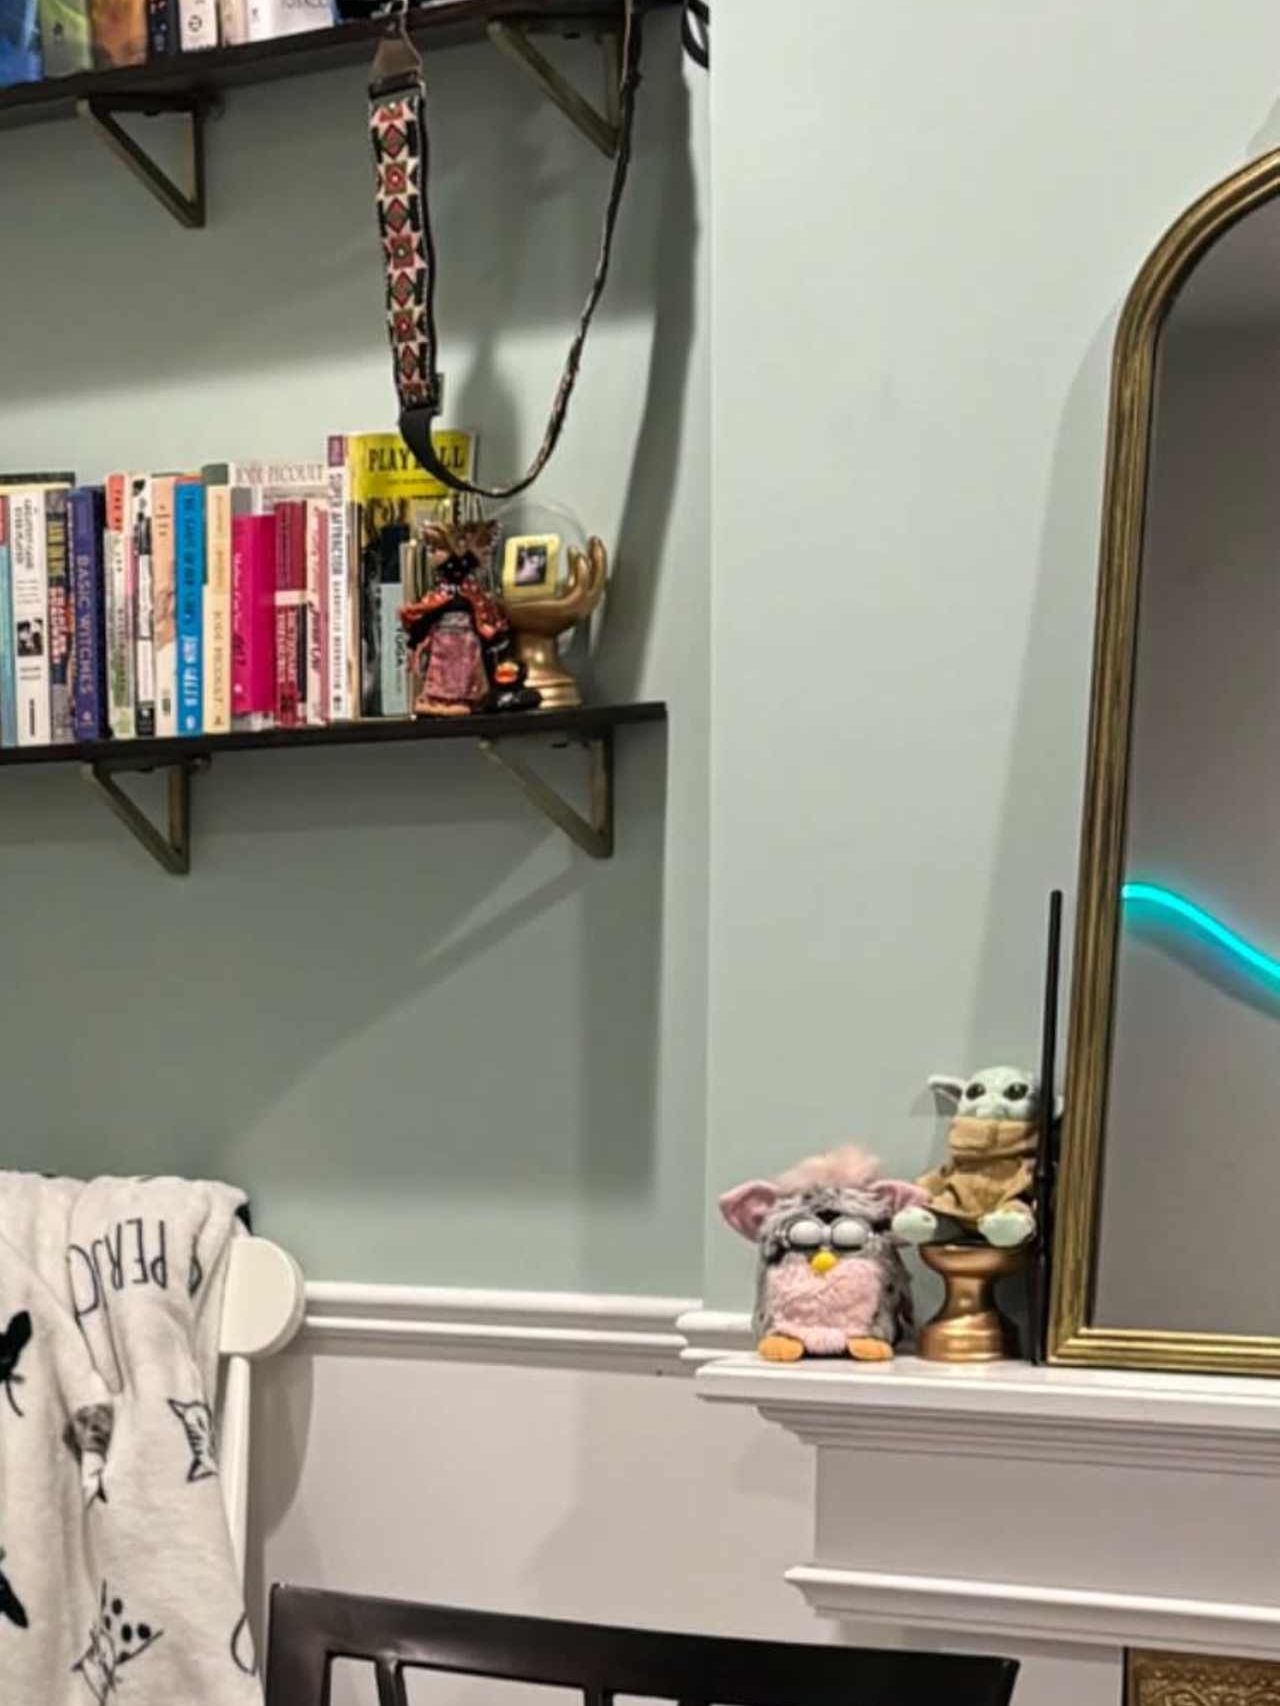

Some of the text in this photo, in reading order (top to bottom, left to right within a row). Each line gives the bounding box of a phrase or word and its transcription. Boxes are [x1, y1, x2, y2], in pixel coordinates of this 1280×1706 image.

[368, 445, 465, 471] PLAYLL
[331, 512, 343, 575] ATTRACTOR
[76, 554, 94, 694] BASIC WITCHES
